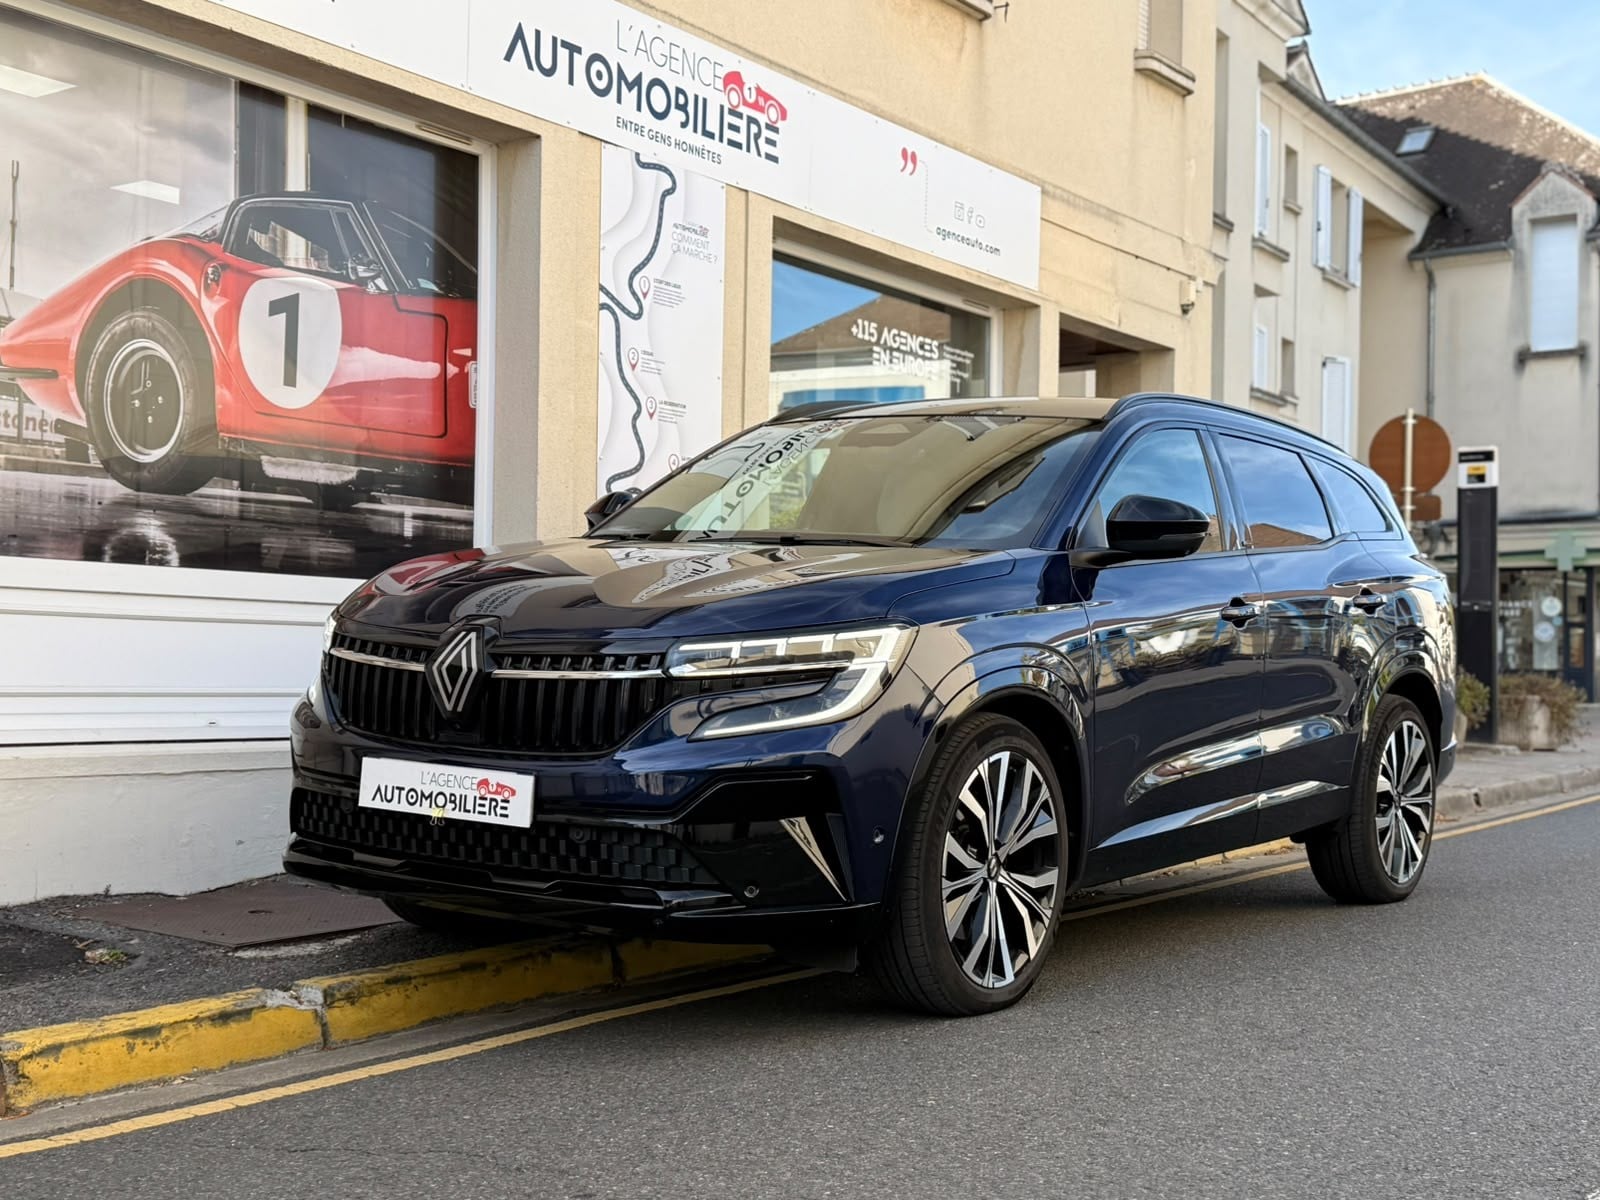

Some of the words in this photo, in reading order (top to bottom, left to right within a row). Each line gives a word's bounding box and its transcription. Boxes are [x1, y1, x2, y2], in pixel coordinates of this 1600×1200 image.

[616, 19, 724, 93] L'AGENCE
[616, 115, 646, 138] ENTRE
[647, 128, 672, 147] GENS
[674, 138, 722, 165] HONNÊTES
[936, 226, 1001, 256] agenceauto.com
[268, 292, 300, 389] 1
[851, 318, 878, 343] +115
[880, 326, 939, 359] AGENCES
[872, 345, 890, 368] EN
[420, 771, 478, 791] L'AGENCE
